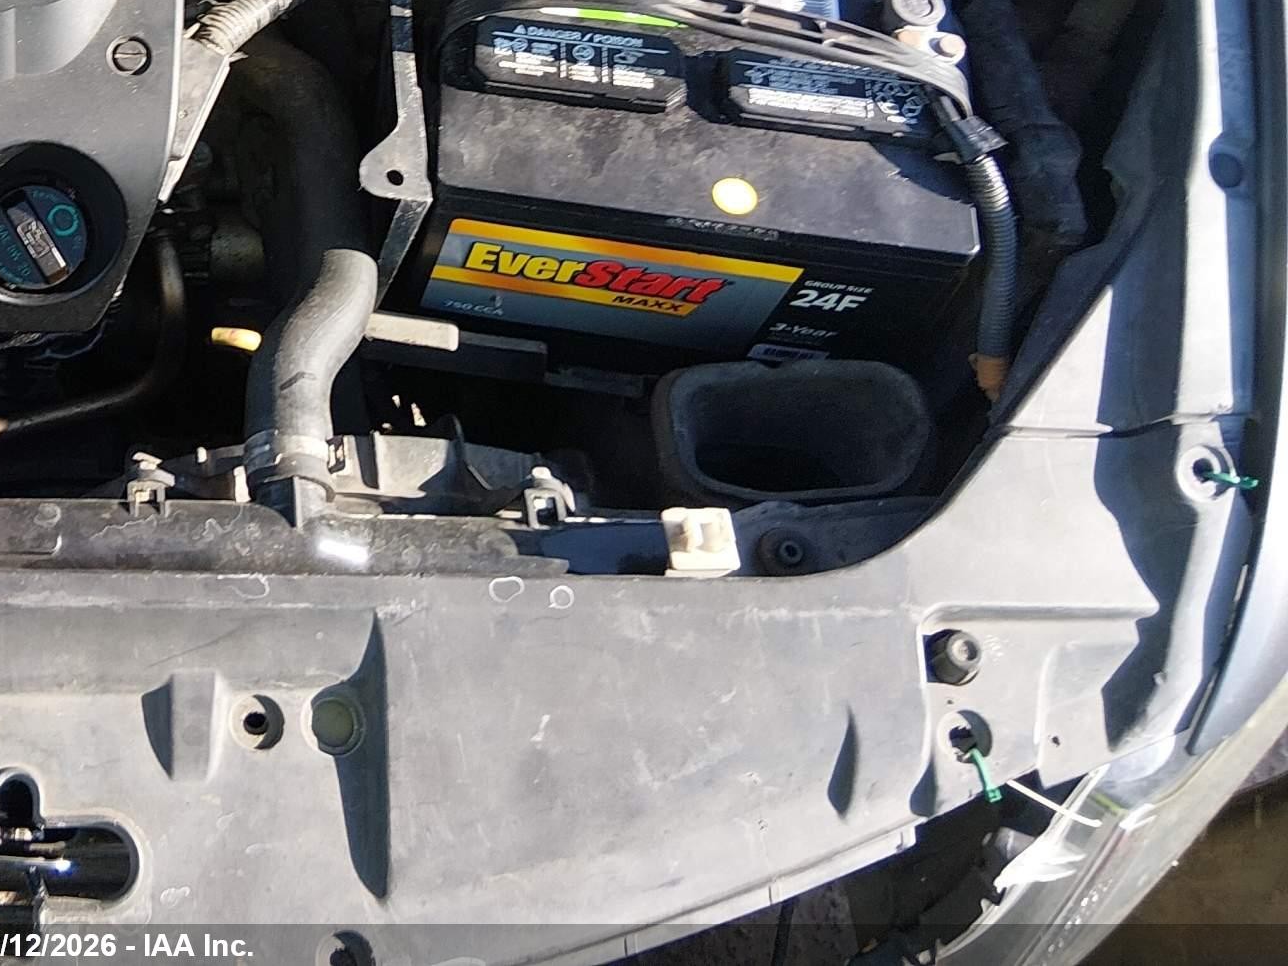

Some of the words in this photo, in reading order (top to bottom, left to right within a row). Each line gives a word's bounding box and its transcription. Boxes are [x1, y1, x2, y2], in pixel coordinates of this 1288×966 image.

[526, 26, 582, 42] DANGER
[593, 34, 644, 49] POISON
[462, 240, 728, 305] EverStart
[804, 279, 846, 291] GROUP
[611, 294, 686, 314] MAXX
[789, 288, 868, 313] 24F
[768, 322, 840, 339] 3-Year
